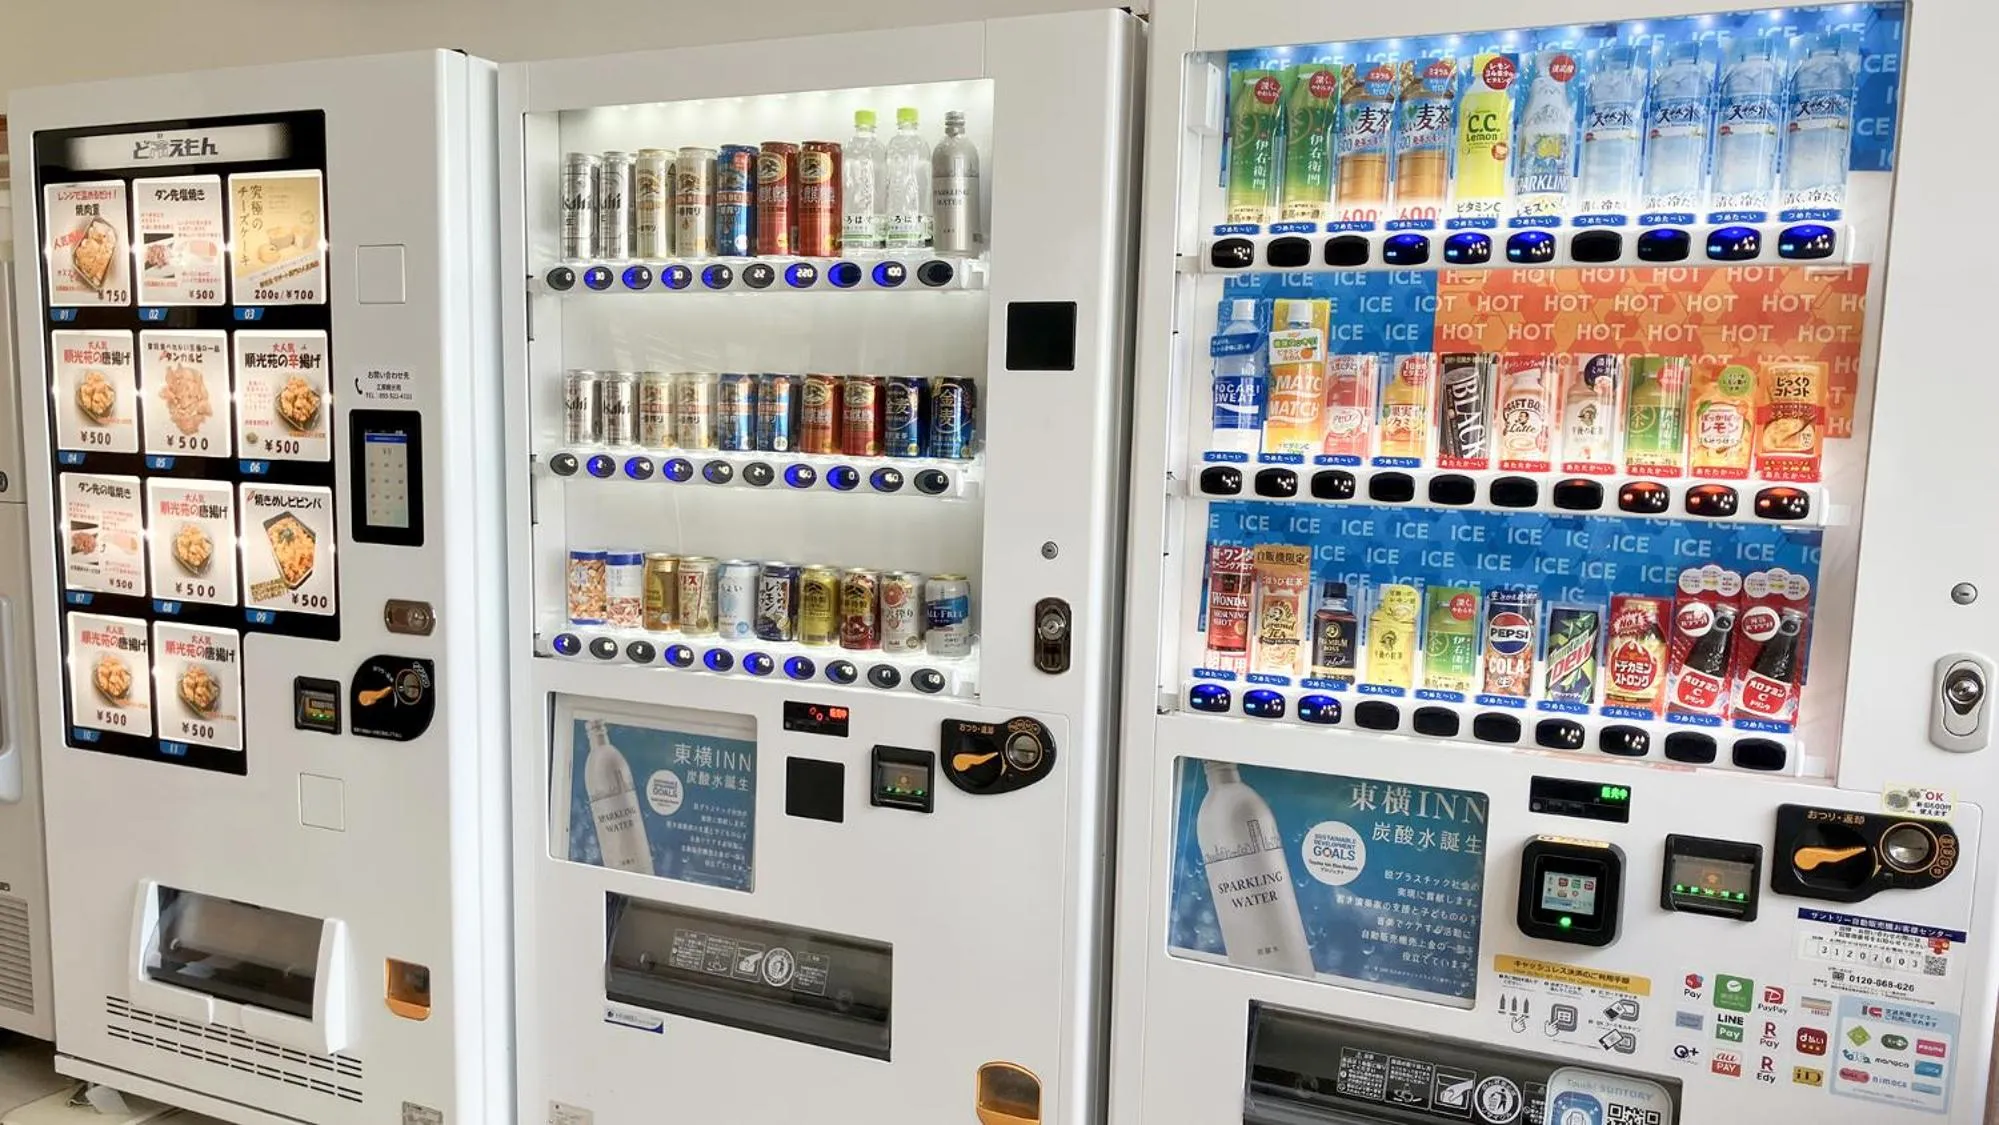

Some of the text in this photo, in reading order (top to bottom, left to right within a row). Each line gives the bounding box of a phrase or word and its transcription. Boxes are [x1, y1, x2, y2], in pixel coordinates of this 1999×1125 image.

[1657, 104, 1699, 123] 天然水
[1728, 103, 1772, 121] 天然水
[1797, 98, 1840, 117] 天然水
[1358, 107, 1392, 134] 麦茶
[1416, 103, 1450, 131] 麦茶
[1468, 113, 1500, 133] C.C.
[1591, 109, 1633, 127] 天然水
[1466, 133, 1497, 142] Lemon
[1253, 139, 1269, 190] 伊右衛門
[1307, 134, 1324, 186] 伊右衛門
[250, 185, 263, 231] 究極の
[1456, 202, 1501, 213] ビタミンC
[237, 186, 250, 266] チーズケーキ
[1360, 296, 1393, 312] ICE
[1477, 294, 1816, 312] HOT HOT HOT HOT HOT
[1385, 324, 1419, 341] ICE
[1442, 323, 1852, 343] HOT HOT HOT HOT HOT HOT
[244, 352, 321, 369] 順光苑の辛揚げ
[1776, 376, 1810, 387] じっくり
[1774, 387, 1810, 397] コトコト
[1452, 376, 1486, 458] BLACK
[1701, 421, 1738, 433] レモン
[80, 431, 112, 446] ¥500
[167, 435, 209, 451] ¥500
[264, 440, 300, 455] ¥500
[1289, 517, 1775, 561] ICE ICE ICE ICE ICE ICE ICE
[1257, 550, 1305, 564] 自販機限定
[1313, 545, 1512, 571] ICE ICE ICE ICE
[176, 582, 216, 598] ¥500
[291, 594, 328, 609] ¥500
[1490, 628, 1529, 639] PEPSI
[1489, 652, 1525, 675] COLA
[1614, 659, 1652, 674] ドデカミン
[1615, 673, 1650, 687] ストロング
[1684, 674, 1720, 694] オロナミン
[1749, 679, 1786, 698] オロナミン
[1750, 700, 1771, 710] ドリンク
[97, 710, 127, 727] ¥500
[182, 722, 214, 739] ¥500
[673, 743, 751, 772] 東横INN
[686, 769, 749, 792] 炭酸水誕生
[1350, 783, 1486, 825] 東横INN
[1926, 791, 1944, 801] OK
[1807, 810, 1865, 825] おつり・返却
[1372, 822, 1482, 854] 炭酸水誕生
[1313, 846, 1356, 861] GOALS
[1216, 871, 1284, 896] SPARKLING
[1384, 869, 1480, 891] 脱プラスチック社会の
[1231, 891, 1279, 910] WATER
[1397, 887, 1479, 908] 実現に貢献します。
[1811, 911, 1953, 938] サントリー自動販売機お客様センター
[1684, 989, 1702, 1000] Pay
[1757, 1003, 1788, 1015] PayPay
[1717, 1013, 1745, 1026] LINE
[1719, 1027, 1741, 1040] Pay
[1764, 1021, 1777, 1037] R
[1760, 1038, 1780, 1050] Pay
[1716, 1052, 1738, 1063] au
[1761, 1056, 1775, 1071] R
[1716, 1062, 1737, 1072] PAY
[1756, 1072, 1776, 1084] Edy
[1872, 1076, 1908, 1088] nimoca
